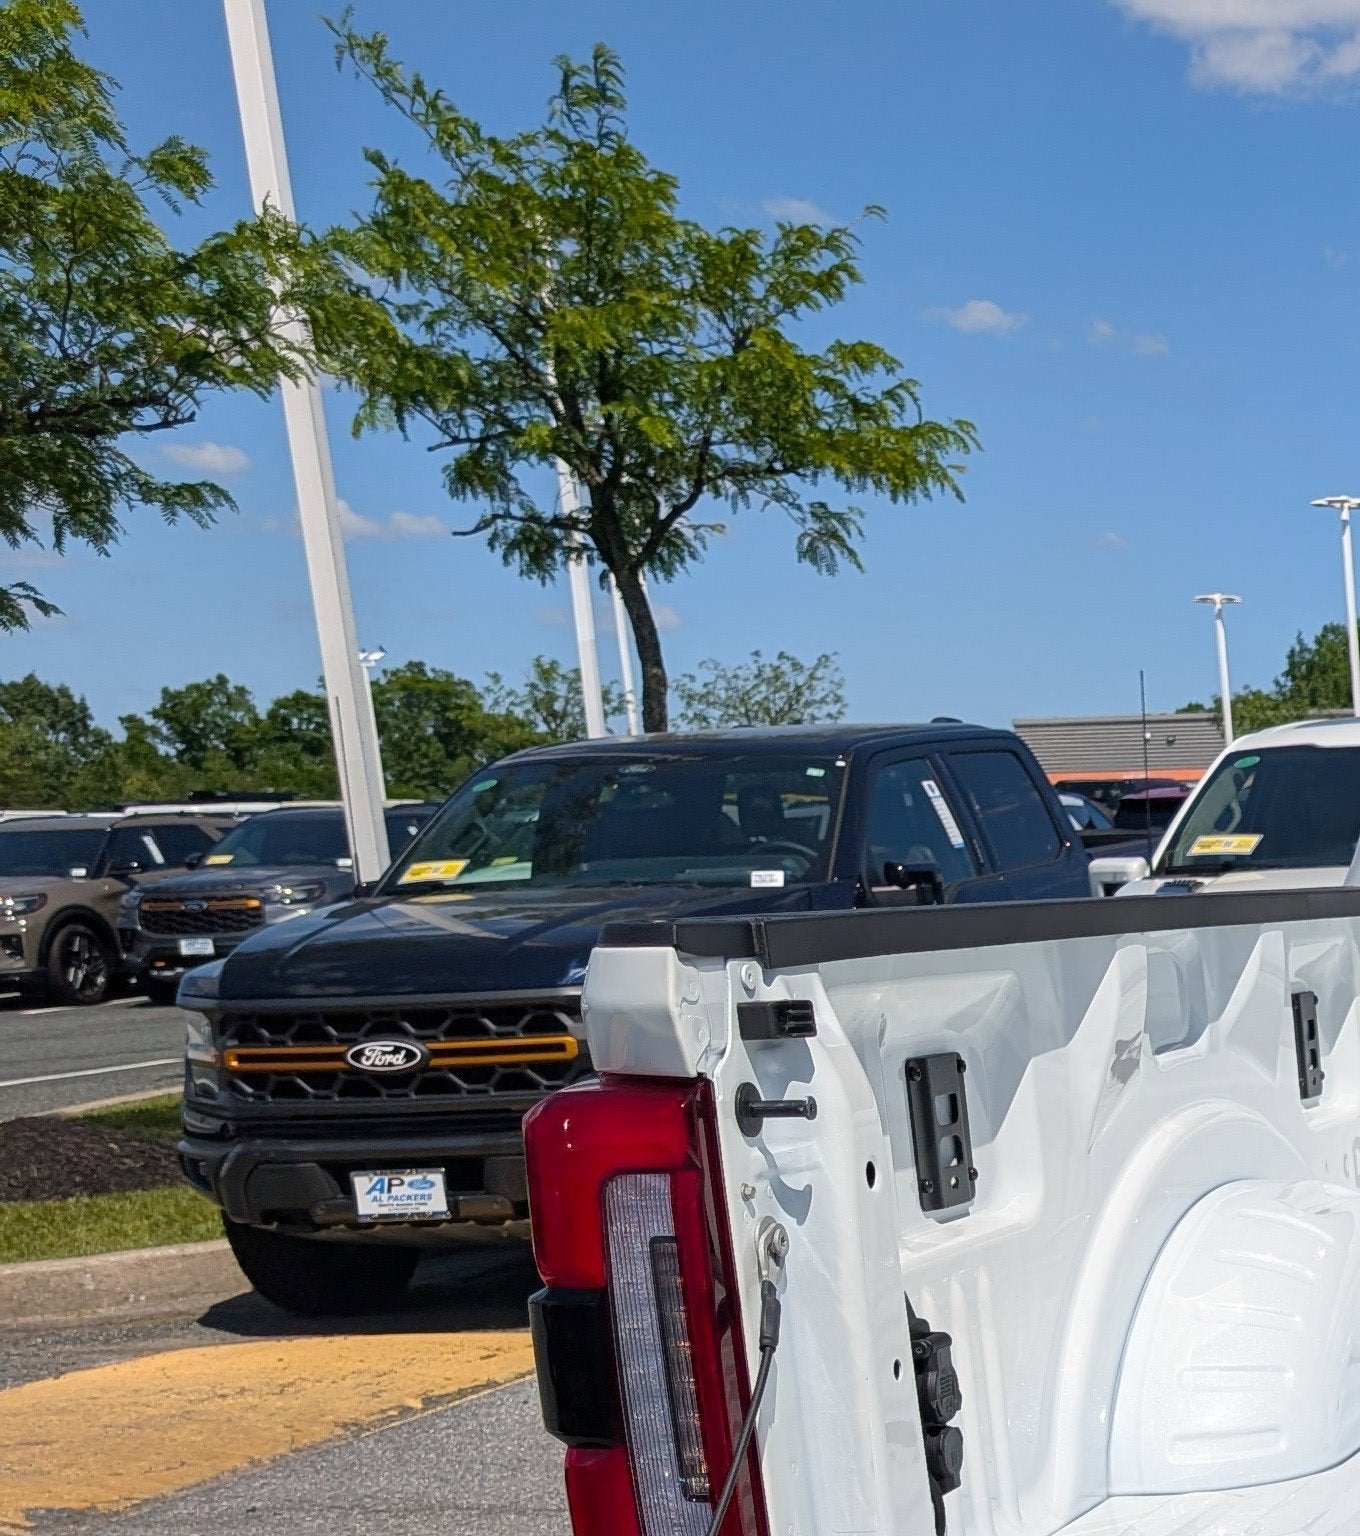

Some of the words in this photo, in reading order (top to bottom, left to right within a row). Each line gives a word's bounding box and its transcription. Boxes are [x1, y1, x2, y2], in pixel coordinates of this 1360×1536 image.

[361, 1045, 407, 1066] Ford
[365, 1176, 405, 1195] AP
[371, 1195, 383, 1203] AL
[388, 1193, 433, 1202] PACKERS
